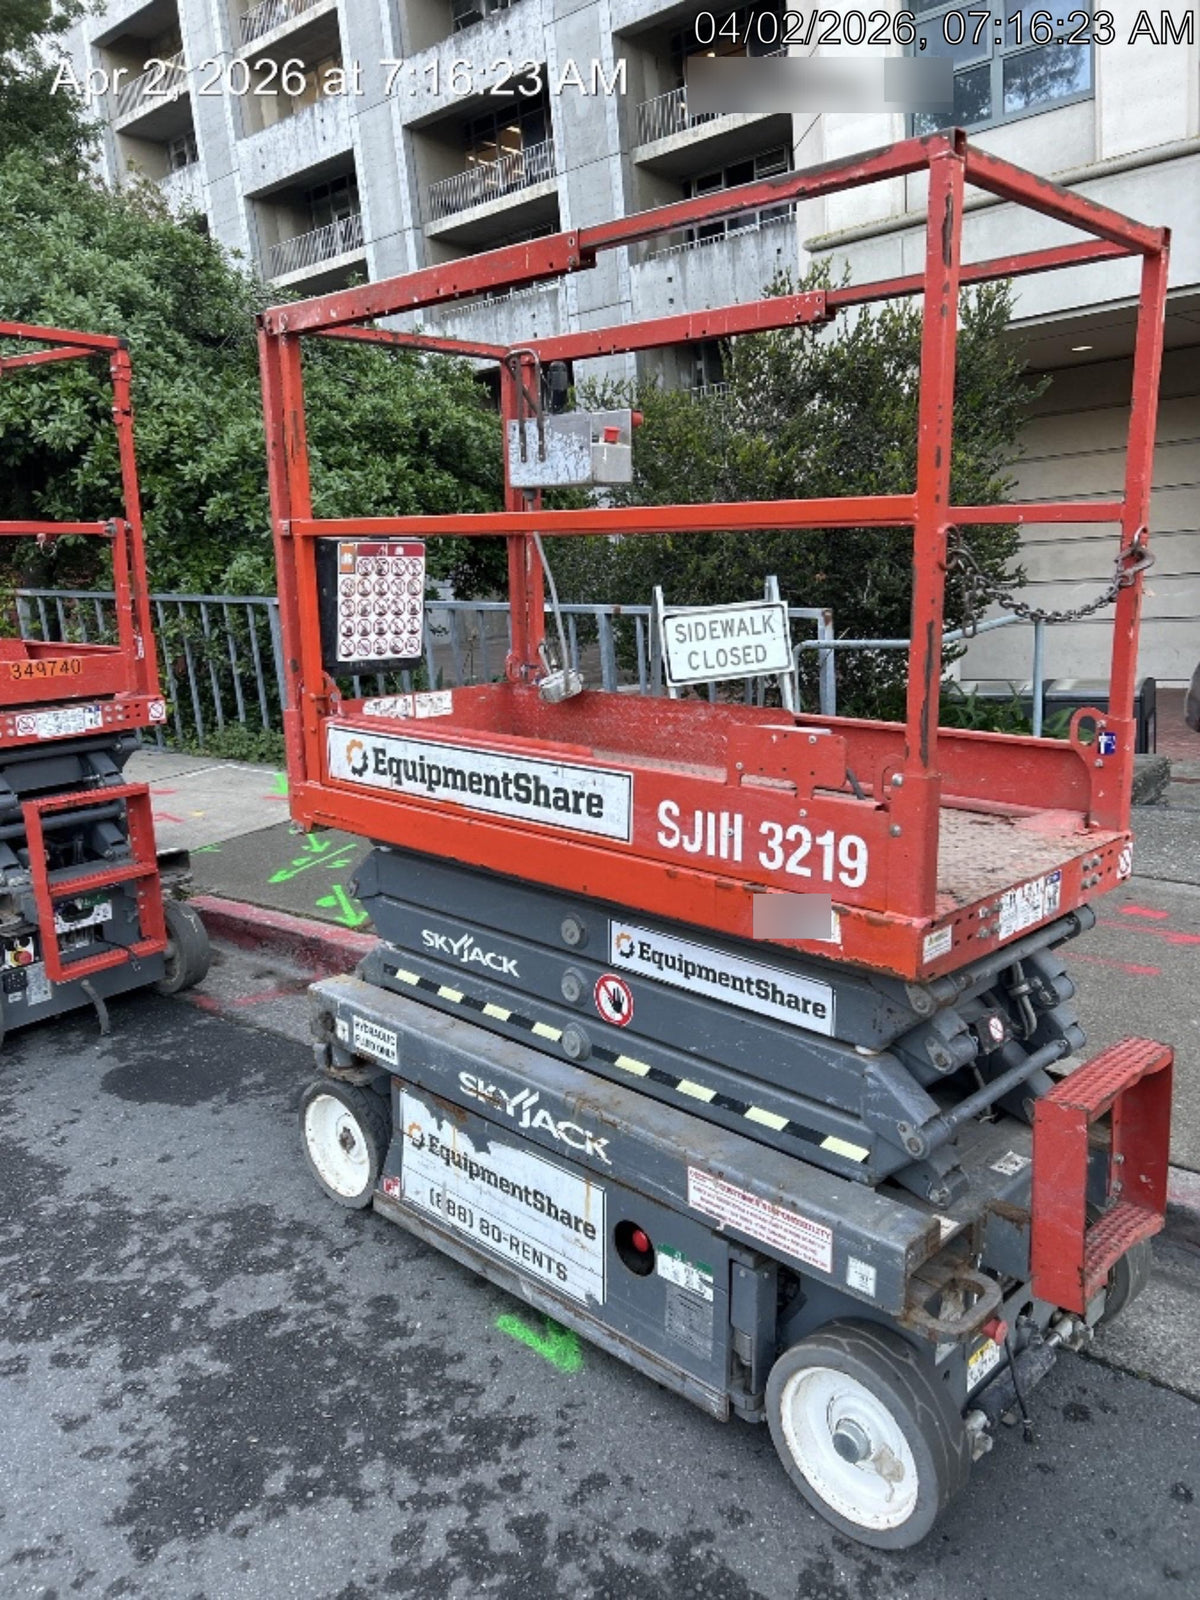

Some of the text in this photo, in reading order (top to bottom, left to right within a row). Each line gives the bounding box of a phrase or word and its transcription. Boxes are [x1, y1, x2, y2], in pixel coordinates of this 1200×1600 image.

[674, 614, 776, 644] SIDEWALK
[687, 644, 767, 671] CLOSED
[11, 658, 82, 680] 349740
[372, 746, 604, 818] EquipmentShare
[758, 820, 870, 888] 3219
[421, 928, 520, 979] SKYJACK
[637, 941, 827, 1019] EquipmentShare
[458, 1071, 612, 1165] SKYJACK
[428, 1132, 597, 1241] EquipmentShare
[479, 1217, 569, 1283] 80-RENTS
